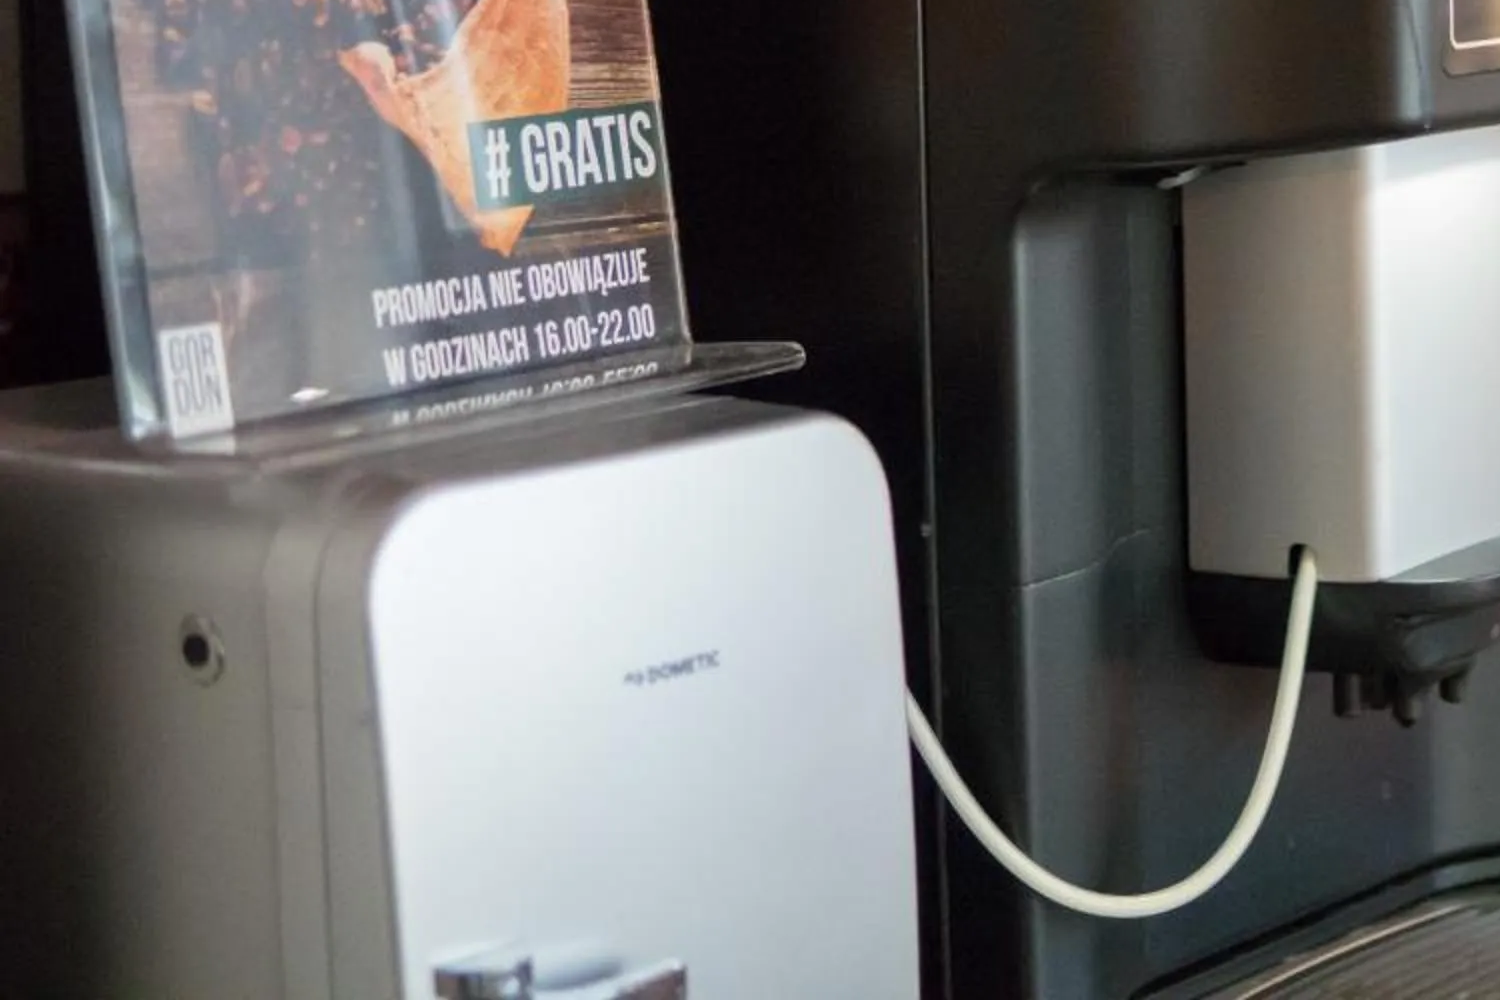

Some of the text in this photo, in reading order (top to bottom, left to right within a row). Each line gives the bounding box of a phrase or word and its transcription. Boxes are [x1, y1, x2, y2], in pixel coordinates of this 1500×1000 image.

[520, 110, 658, 195] GRATIS
[371, 247, 651, 329] PROMOCJA NIE OBOWIĄZUJE
[382, 302, 657, 387] W GODZINACH 16.00-22.00
